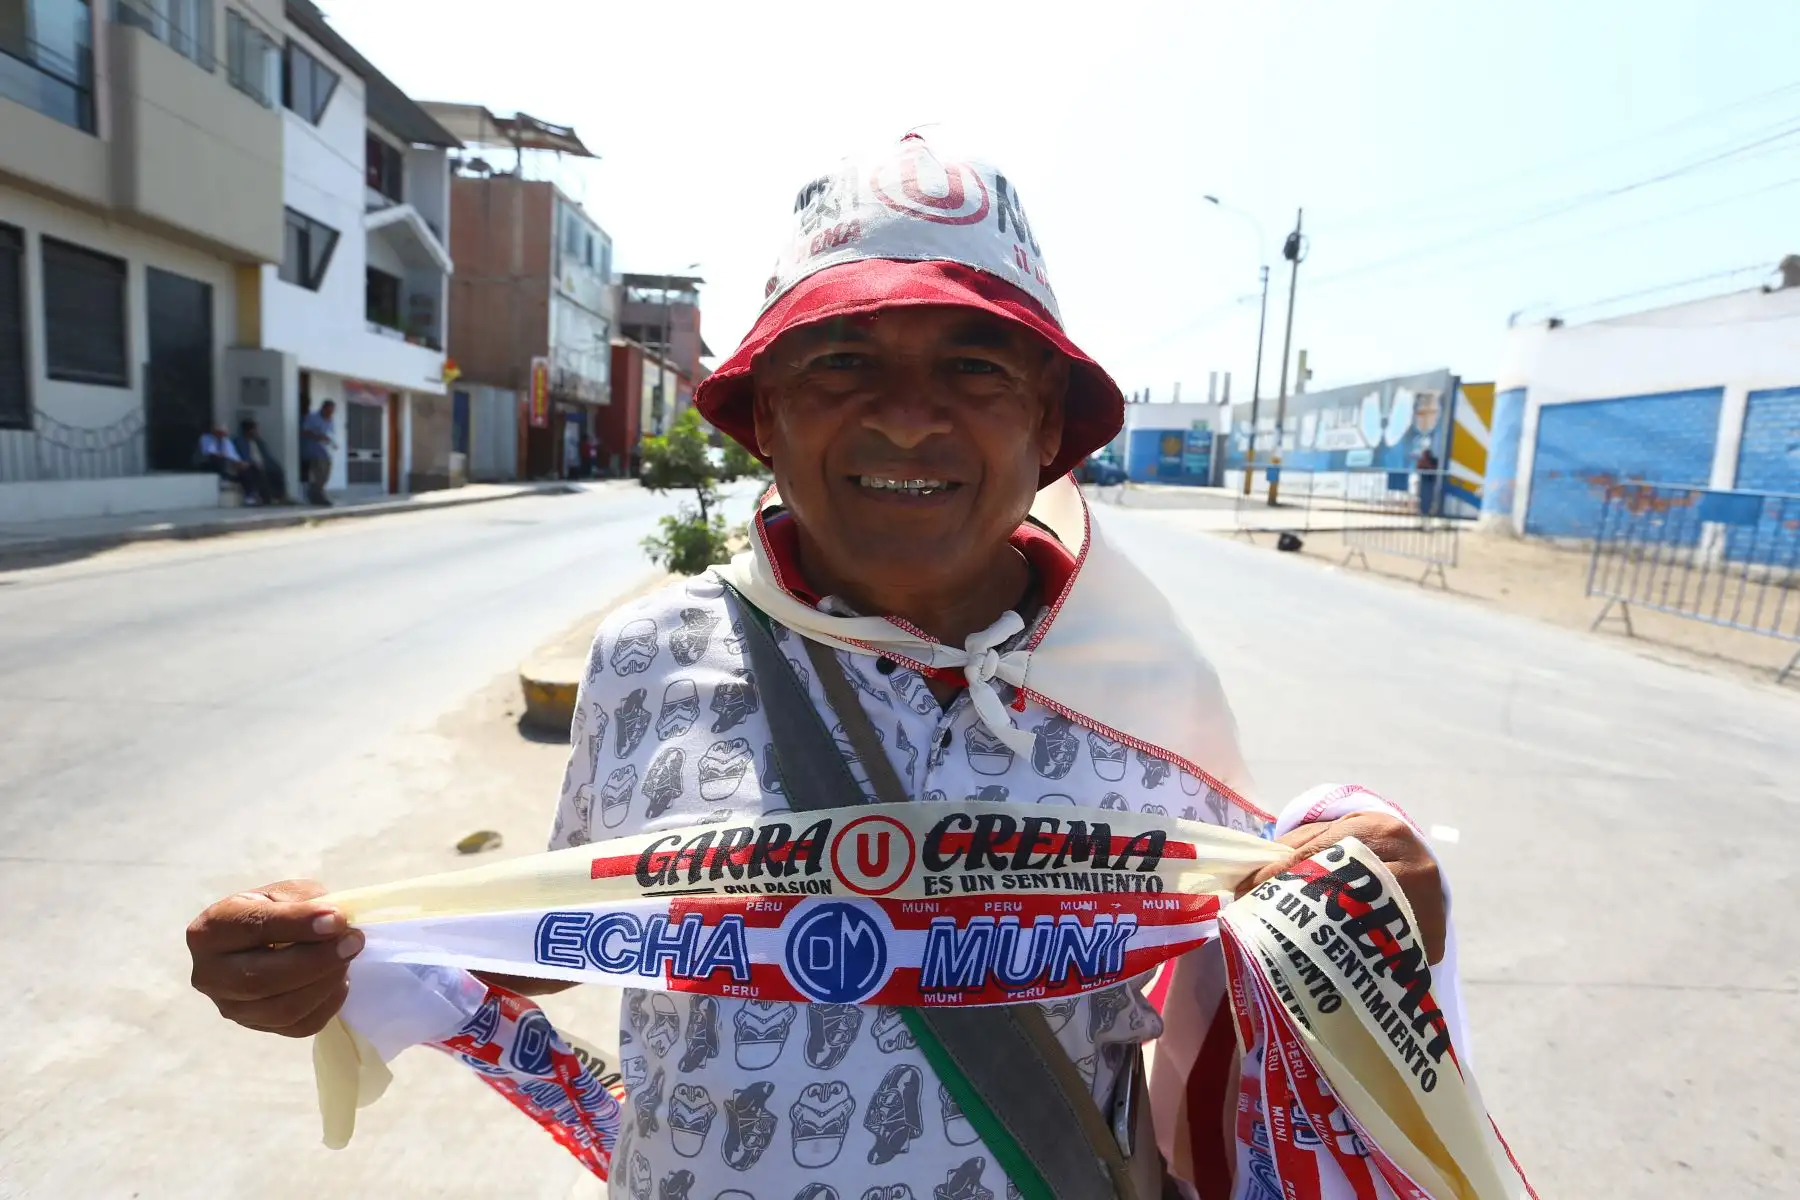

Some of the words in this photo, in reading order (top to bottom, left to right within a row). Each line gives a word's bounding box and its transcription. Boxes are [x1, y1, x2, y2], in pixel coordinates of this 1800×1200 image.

[636, 818, 833, 887] GARRA
[856, 831, 890, 877] U
[922, 812, 1167, 872] CREMA
[746, 901, 783, 912] PERU
[902, 901, 940, 913] MUNI
[984, 900, 1023, 912] PERU
[1142, 899, 1180, 910] MUNI
[924, 876, 952, 896] ES
[962, 875, 996, 893] UN
[1002, 873, 1164, 894] SENTIMIENTO
[534, 911, 752, 983] ECHA
[919, 915, 1138, 992] MUNI
[722, 984, 760, 998] PERU
[924, 991, 963, 1004] MUNI
[1007, 986, 1046, 999] PERU
[1250, 881, 1281, 901] ES
[1276, 892, 1318, 930] UN
[1310, 923, 1438, 1094] SENTIMIENTO
[1286, 1041, 1308, 1080] PERU
[1310, 1112, 1334, 1146] MUNI
[1271, 1105, 1288, 1143] MUNI
